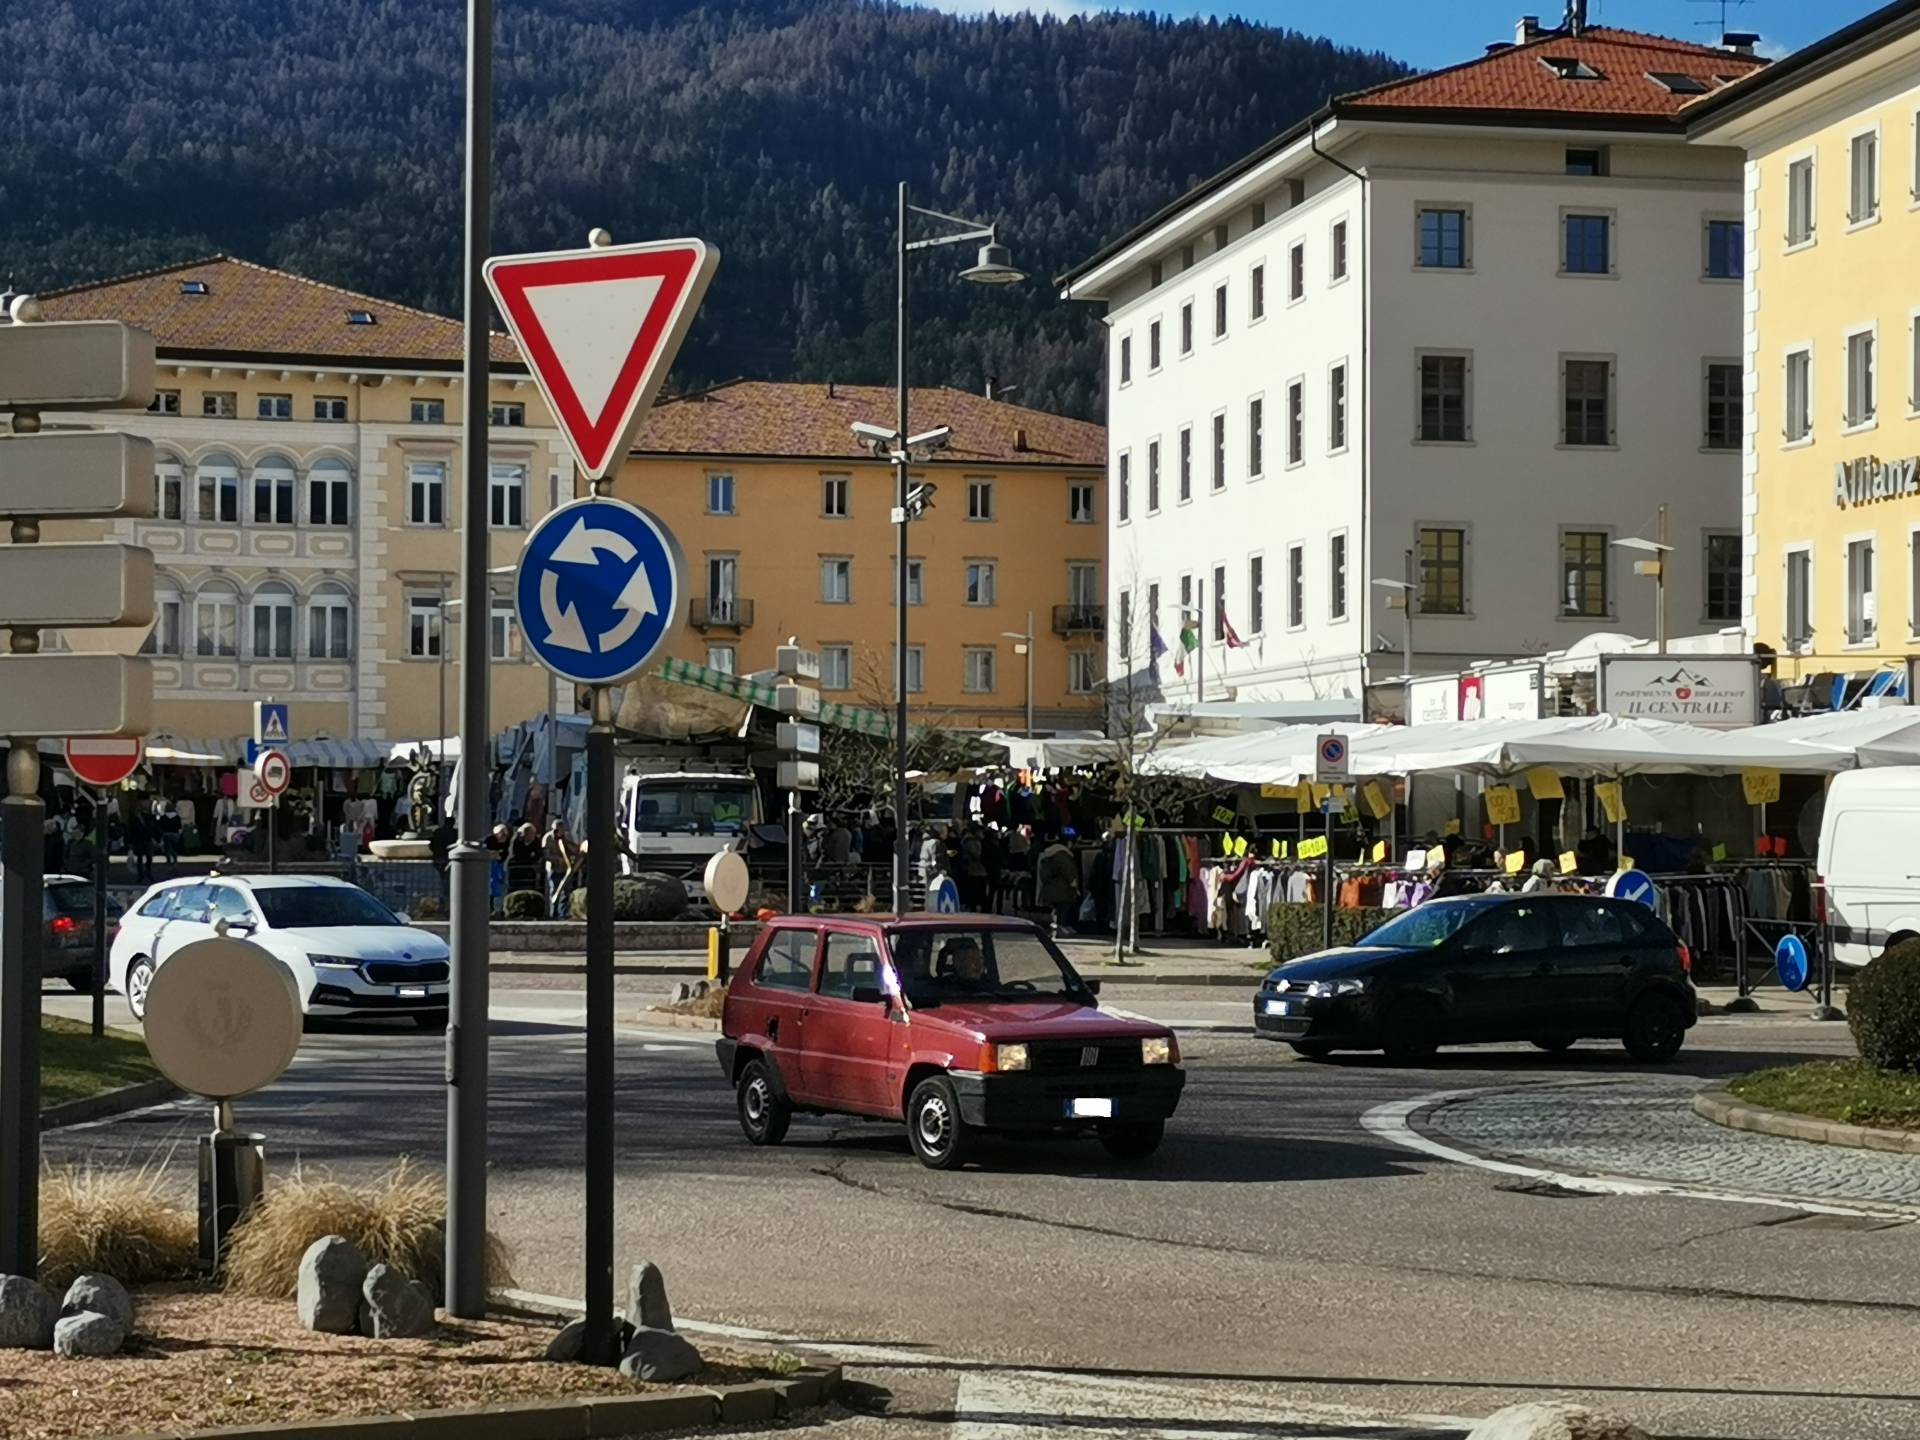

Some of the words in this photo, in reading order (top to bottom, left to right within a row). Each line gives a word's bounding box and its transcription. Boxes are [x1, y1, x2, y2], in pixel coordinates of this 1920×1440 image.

[1834, 456, 1918, 506] Allianz
[1628, 701, 1645, 714] IL
[1648, 701, 1734, 715] CENTRALE
